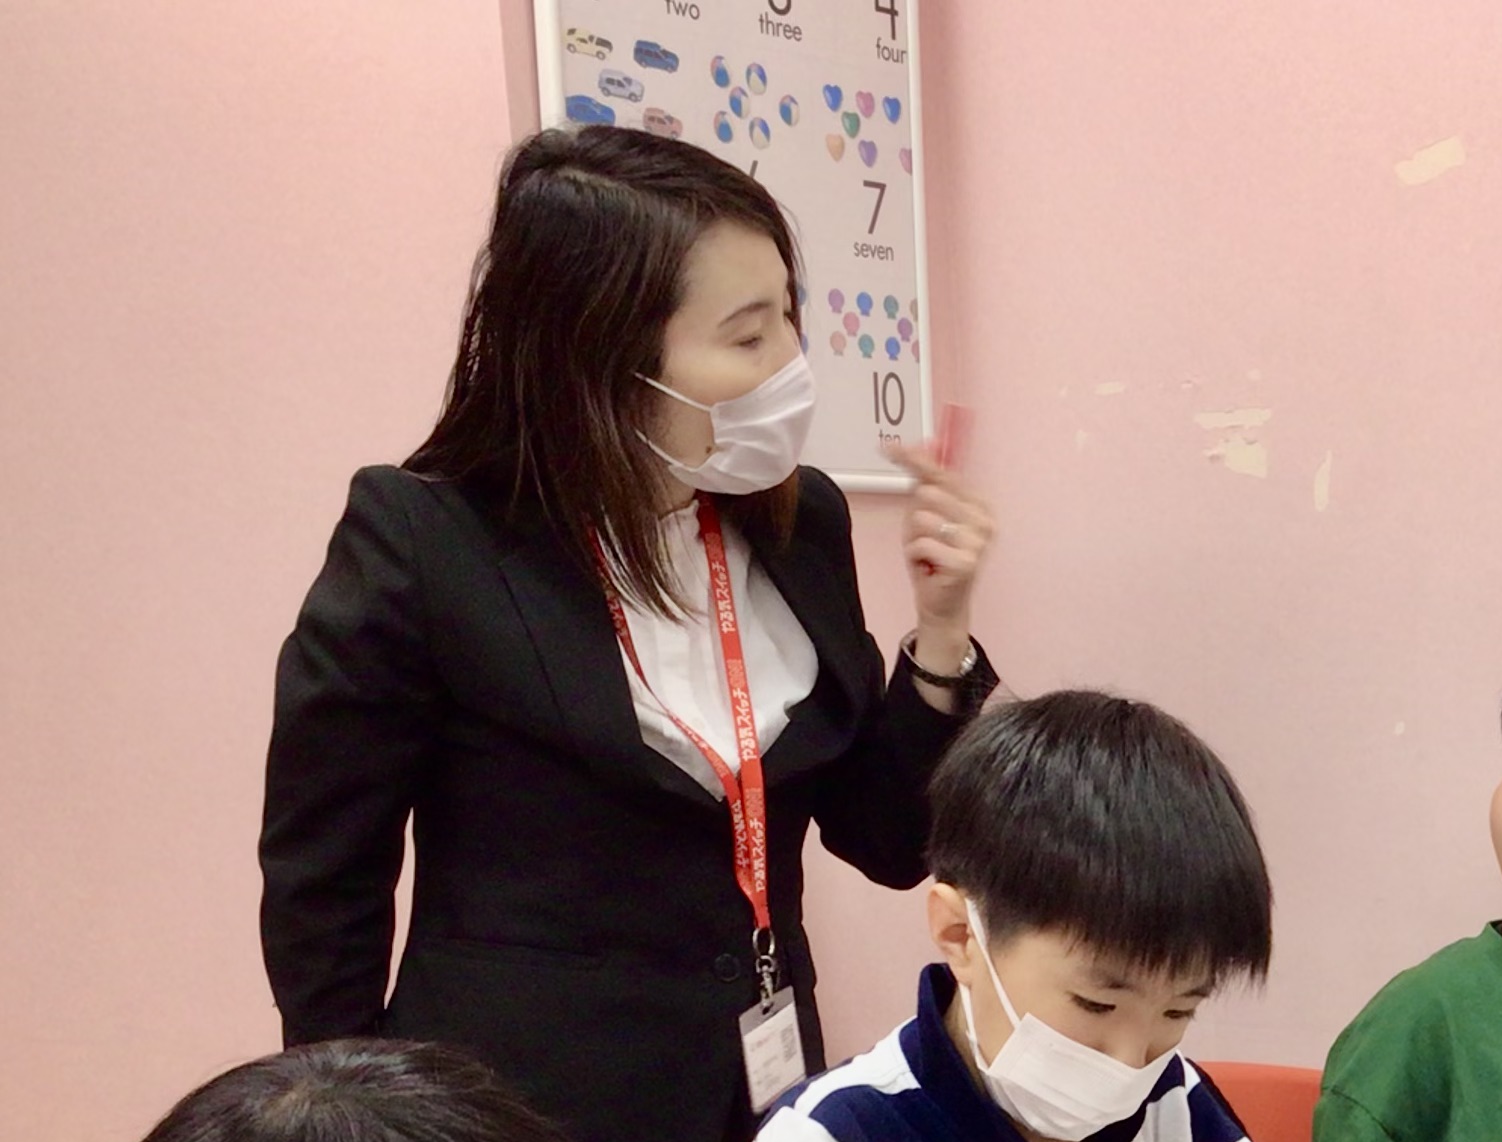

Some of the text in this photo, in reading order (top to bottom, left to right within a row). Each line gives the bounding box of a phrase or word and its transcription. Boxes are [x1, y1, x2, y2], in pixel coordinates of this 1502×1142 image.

[758, 12, 803, 42] three
[876, 36, 907, 64] four
[863, 180, 887, 235] 7
[853, 241, 895, 261] seven
[873, 371, 905, 426] 10
